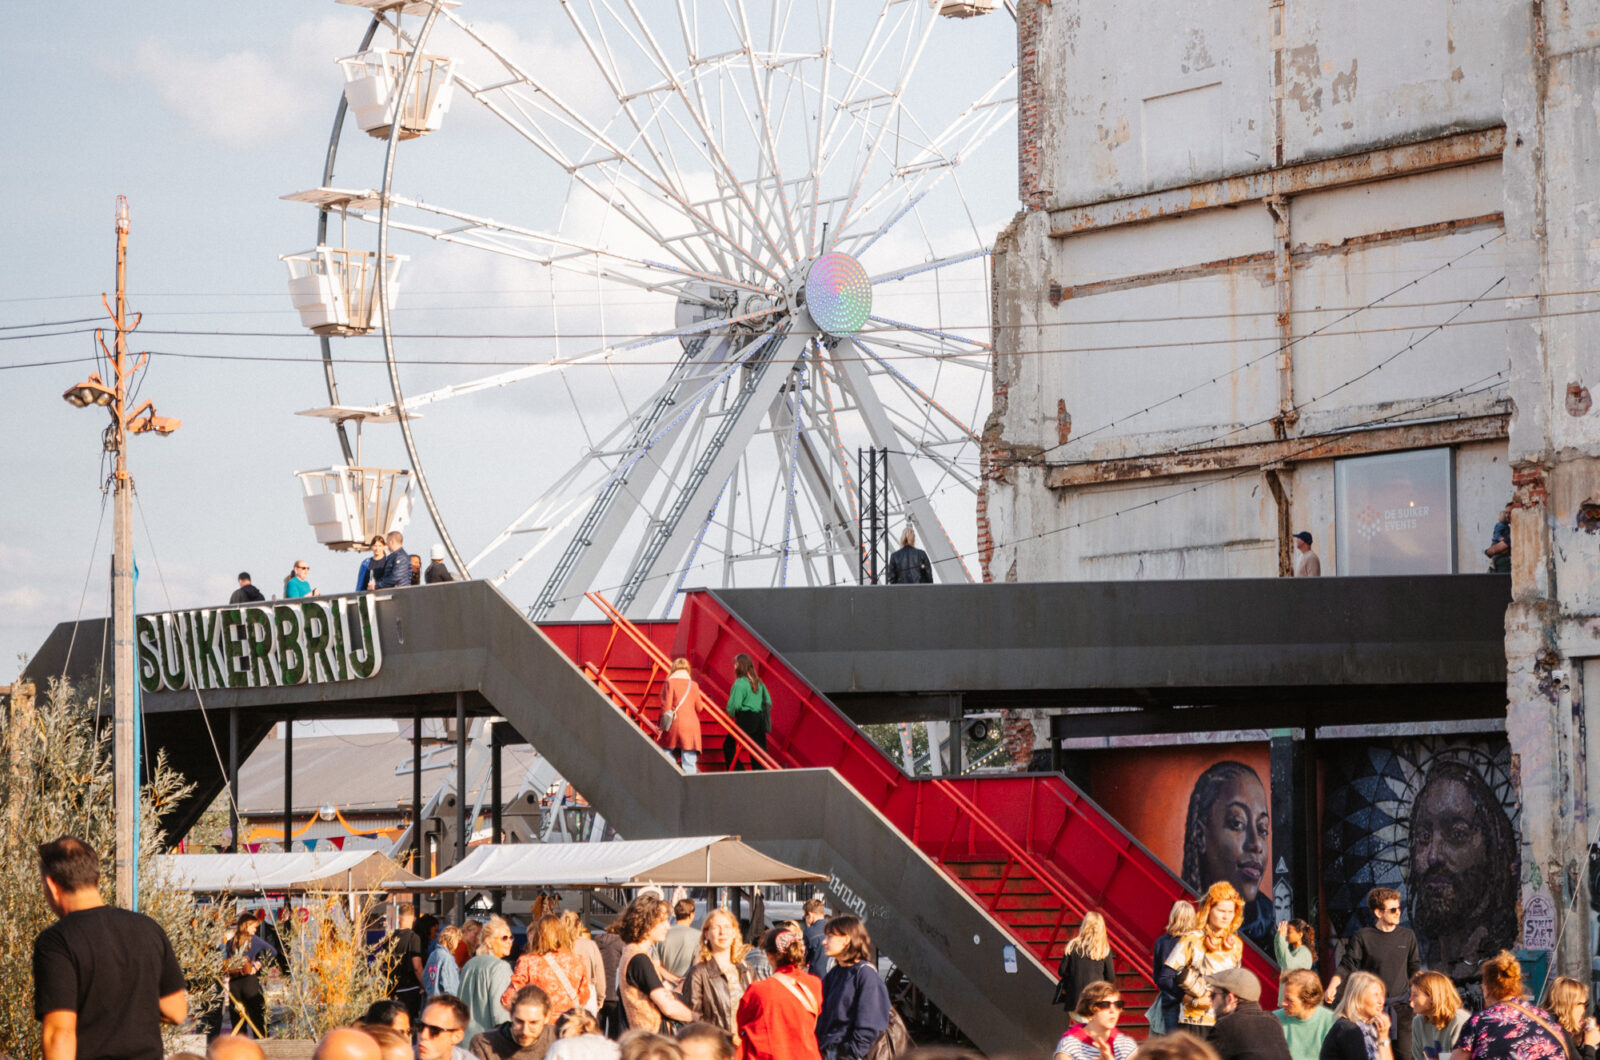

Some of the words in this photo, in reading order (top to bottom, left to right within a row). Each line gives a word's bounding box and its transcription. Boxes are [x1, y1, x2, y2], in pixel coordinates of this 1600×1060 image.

[1384, 509, 1397, 520] DE
[1398, 506, 1429, 519] SUIKER
[1384, 519, 1417, 531] EVENTS
[137, 593, 382, 693] SUIKERBRIJ
[1526, 919, 1553, 934] STREET
[1533, 928, 1553, 938] ART
